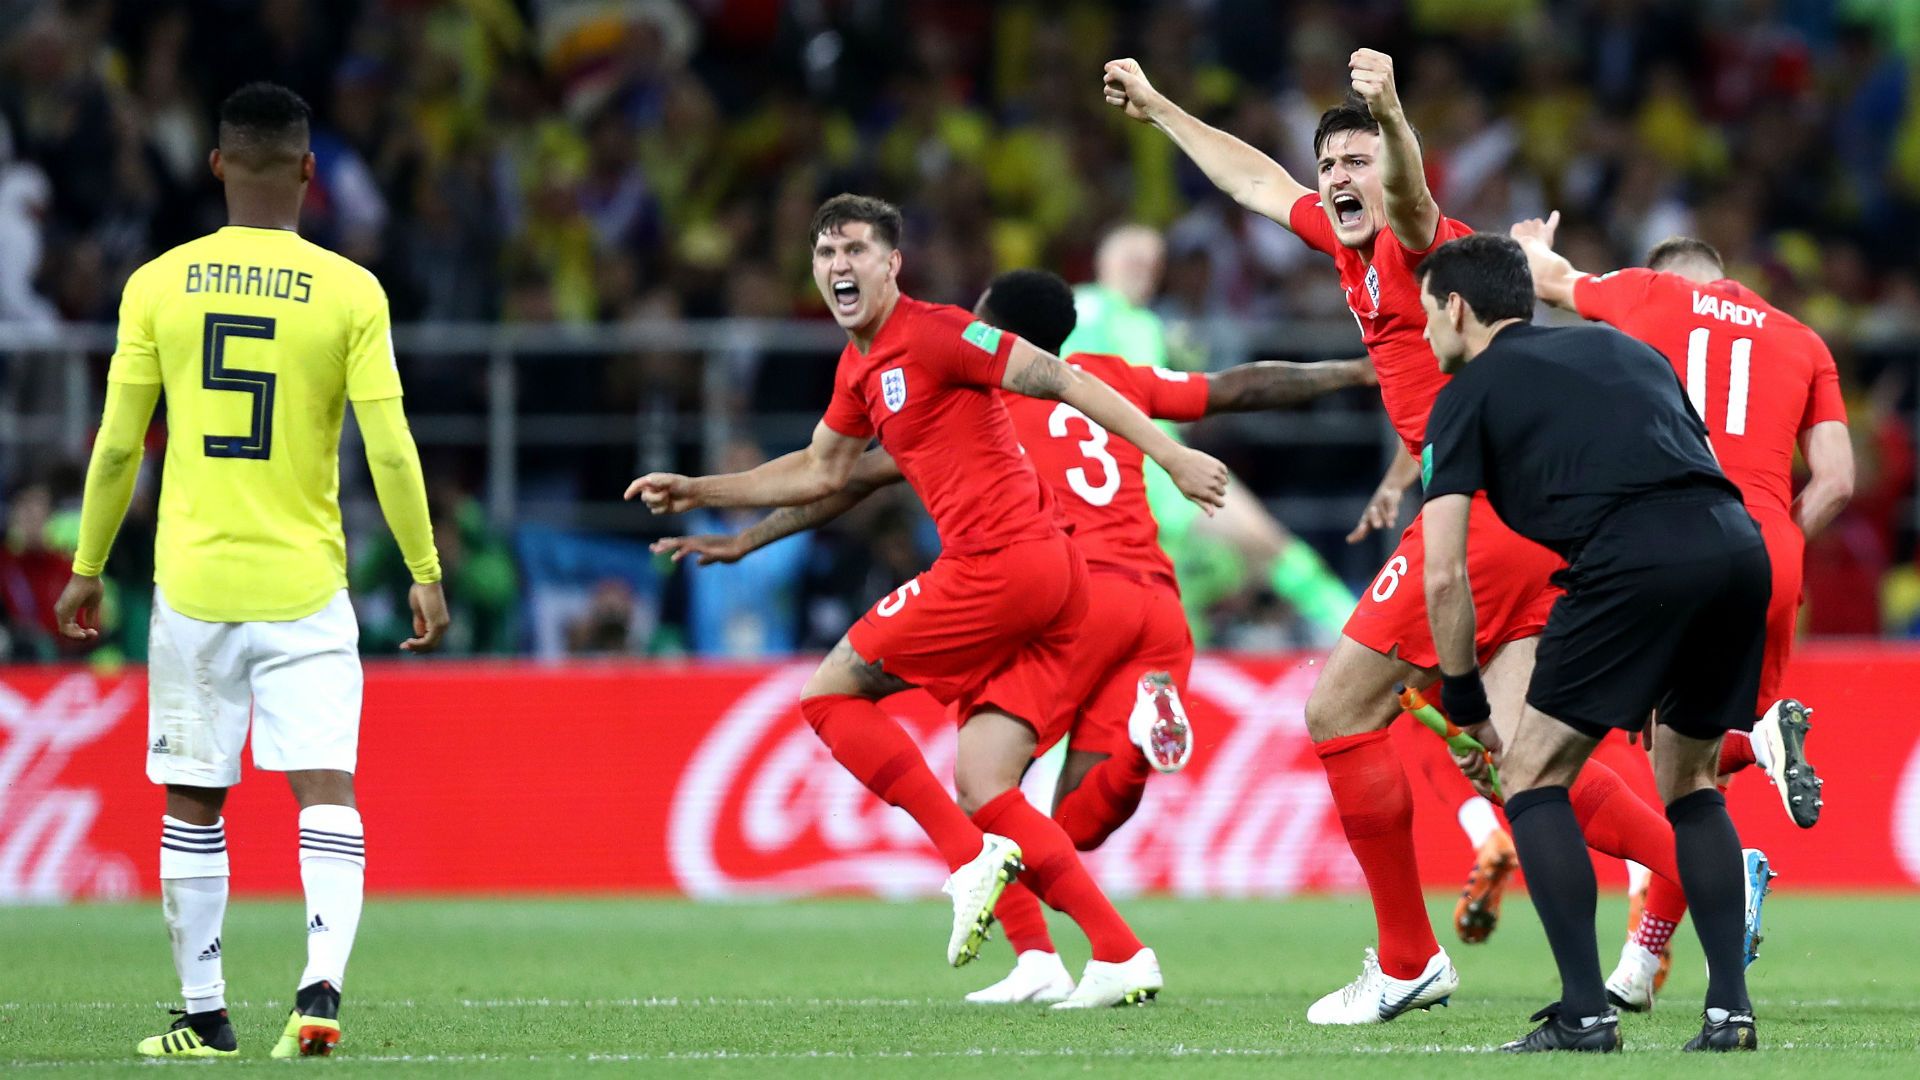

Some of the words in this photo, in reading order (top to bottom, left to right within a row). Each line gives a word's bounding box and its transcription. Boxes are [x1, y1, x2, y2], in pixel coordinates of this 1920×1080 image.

[186, 263, 313, 303] BARRIOS
[1692, 290, 1767, 329] VARDY
[202, 312, 276, 460] 5
[1686, 327, 1752, 435] 11
[1048, 402, 1121, 506] 3
[876, 578, 921, 617] 5
[1372, 555, 1408, 602] 6
